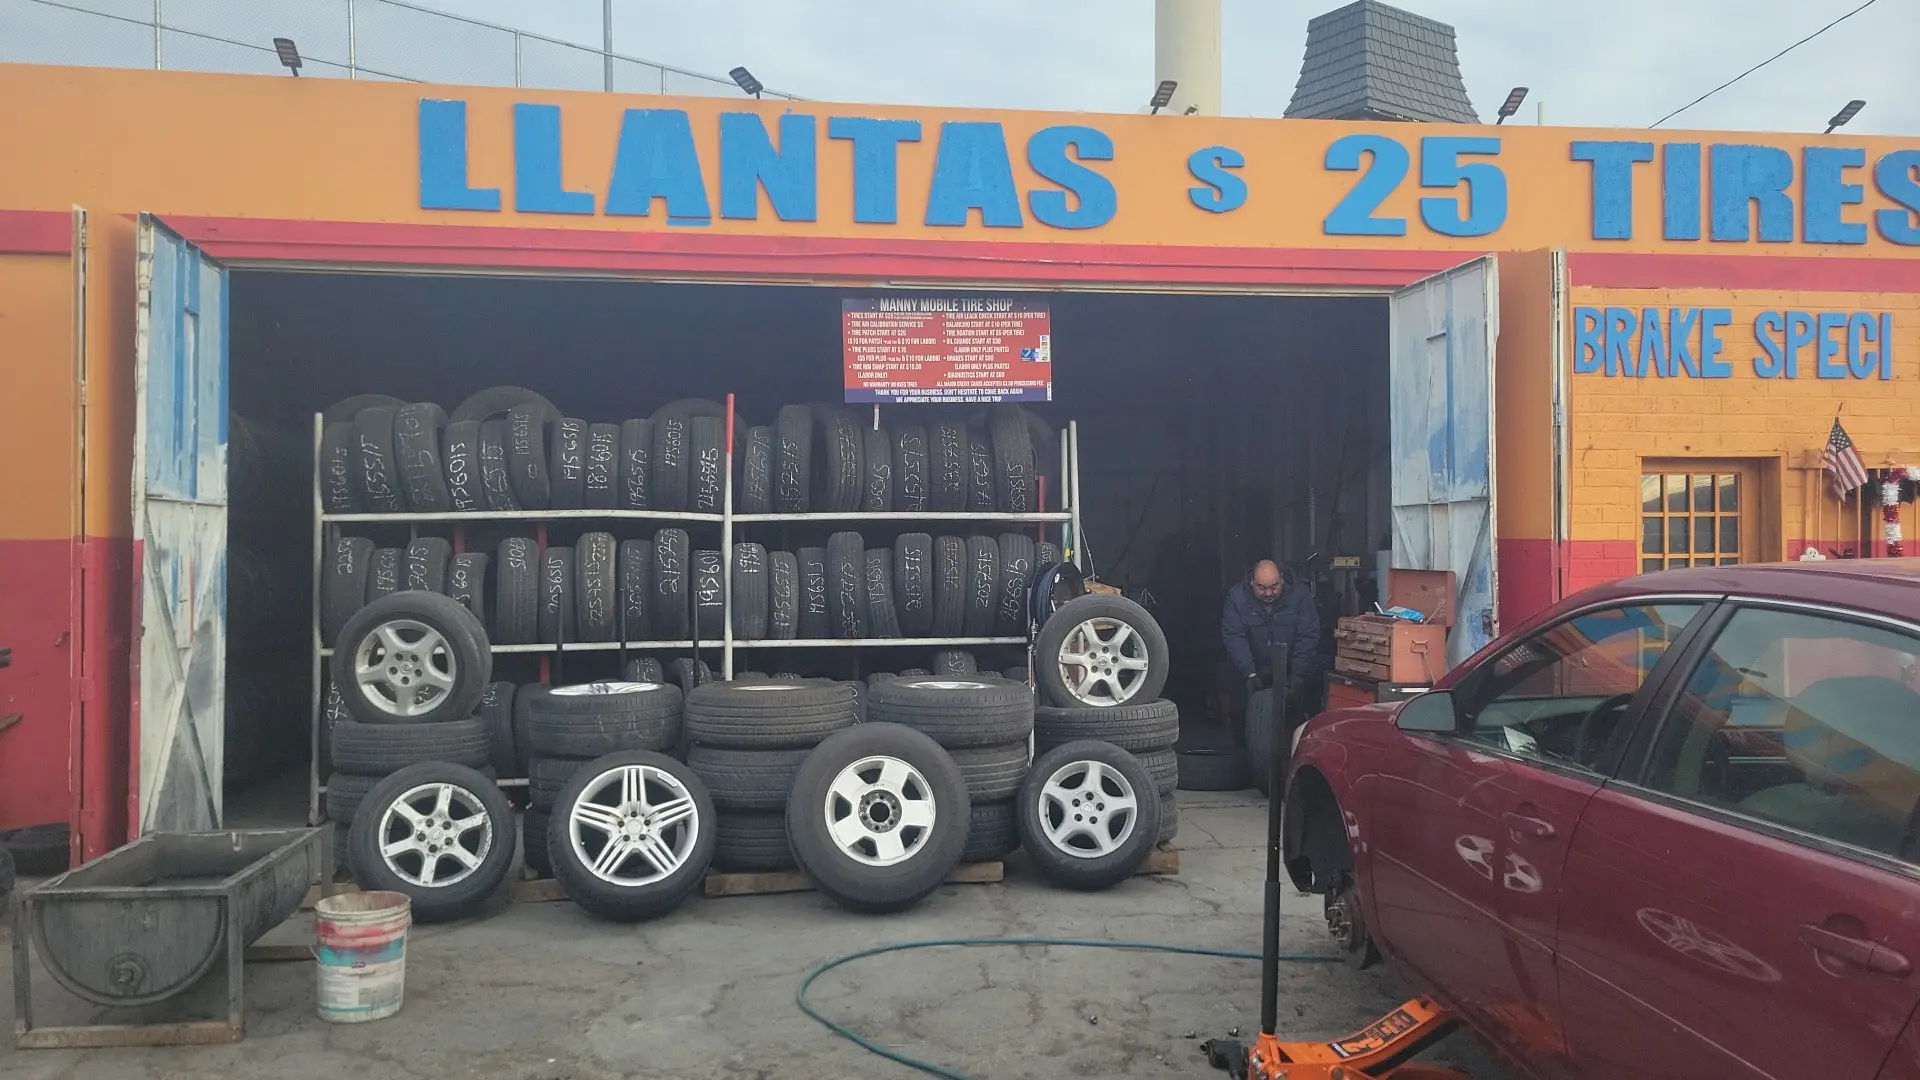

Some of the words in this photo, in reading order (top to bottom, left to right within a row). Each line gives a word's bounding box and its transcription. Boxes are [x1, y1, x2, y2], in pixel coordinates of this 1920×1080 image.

[418, 97, 1118, 229] LLANTAS
[1323, 134, 1508, 237] 25
[1570, 141, 1920, 246] TIRES
[880, 298, 917, 312] MANNY
[920, 298, 959, 312] MOBILE
[961, 298, 983, 312] TIRE
[986, 298, 1013, 312] SHOP
[1575, 306, 1733, 379] BRAKE
[1753, 310, 1893, 381] SPECI
